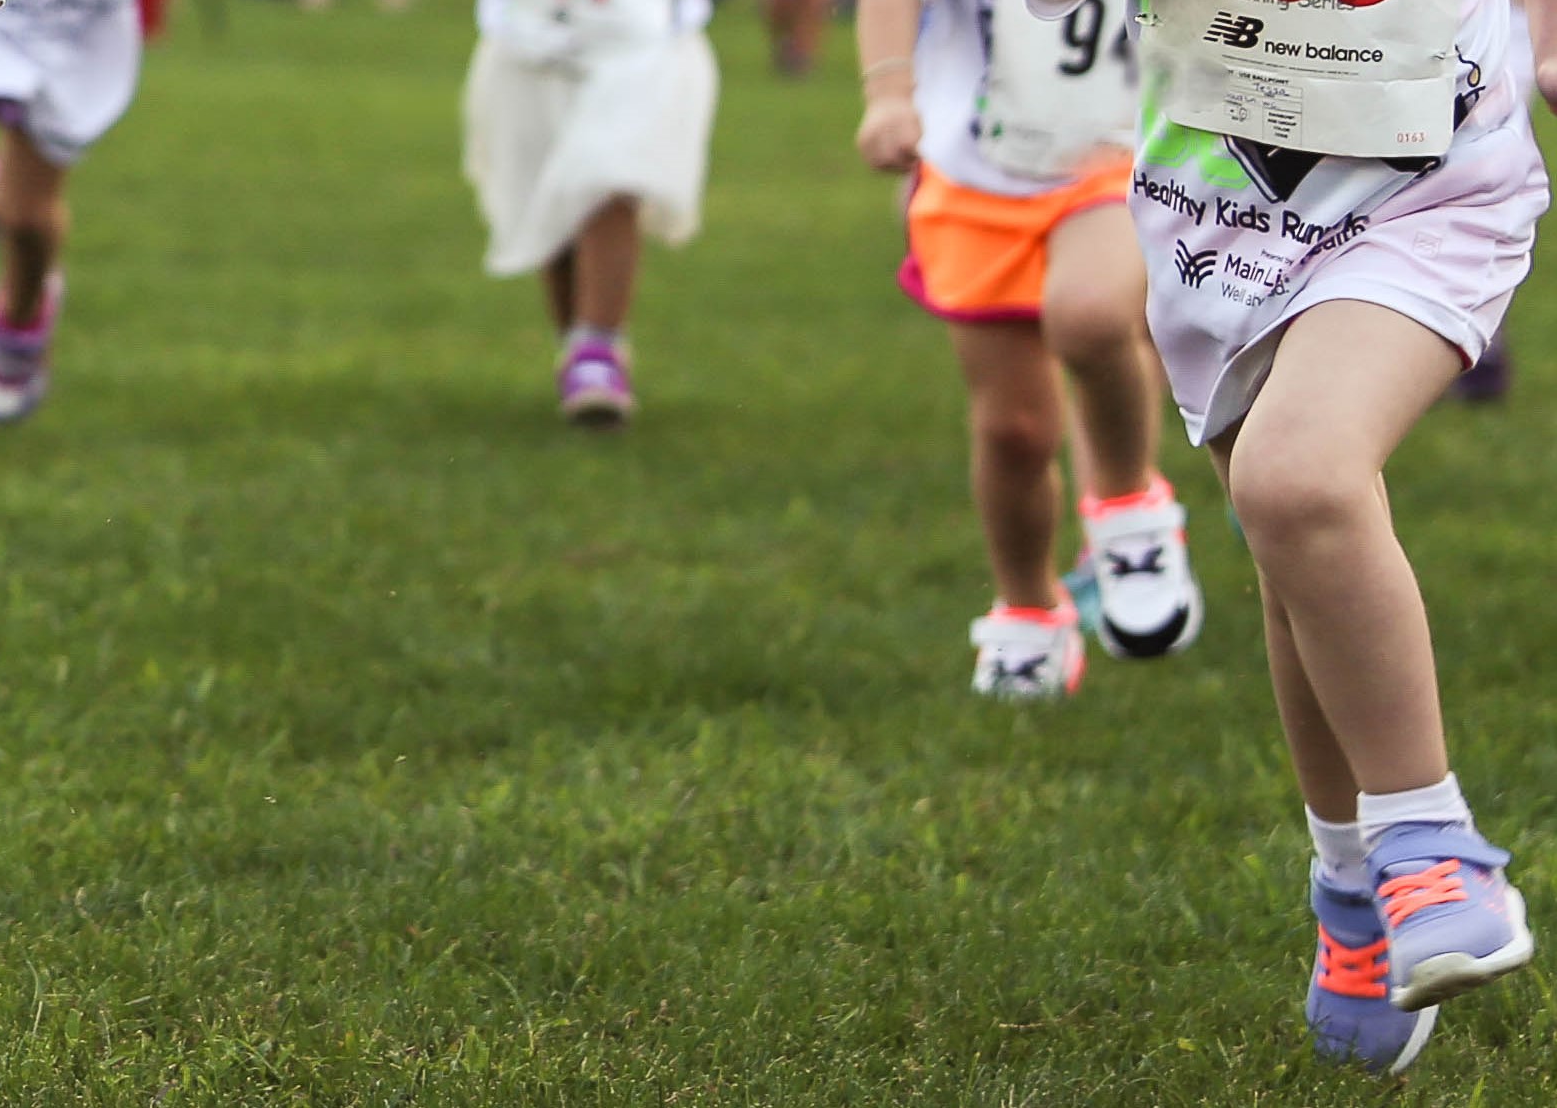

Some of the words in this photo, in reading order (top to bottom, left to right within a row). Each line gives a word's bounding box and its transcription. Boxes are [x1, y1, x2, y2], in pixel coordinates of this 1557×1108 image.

[1264, 41, 1300, 57] new
[1305, 43, 1383, 63] balance
[1133, 170, 1206, 226] Healthy
[1216, 196, 1270, 233] Kids
[1224, 253, 1264, 285] Main
[1221, 281, 1245, 303] Well
